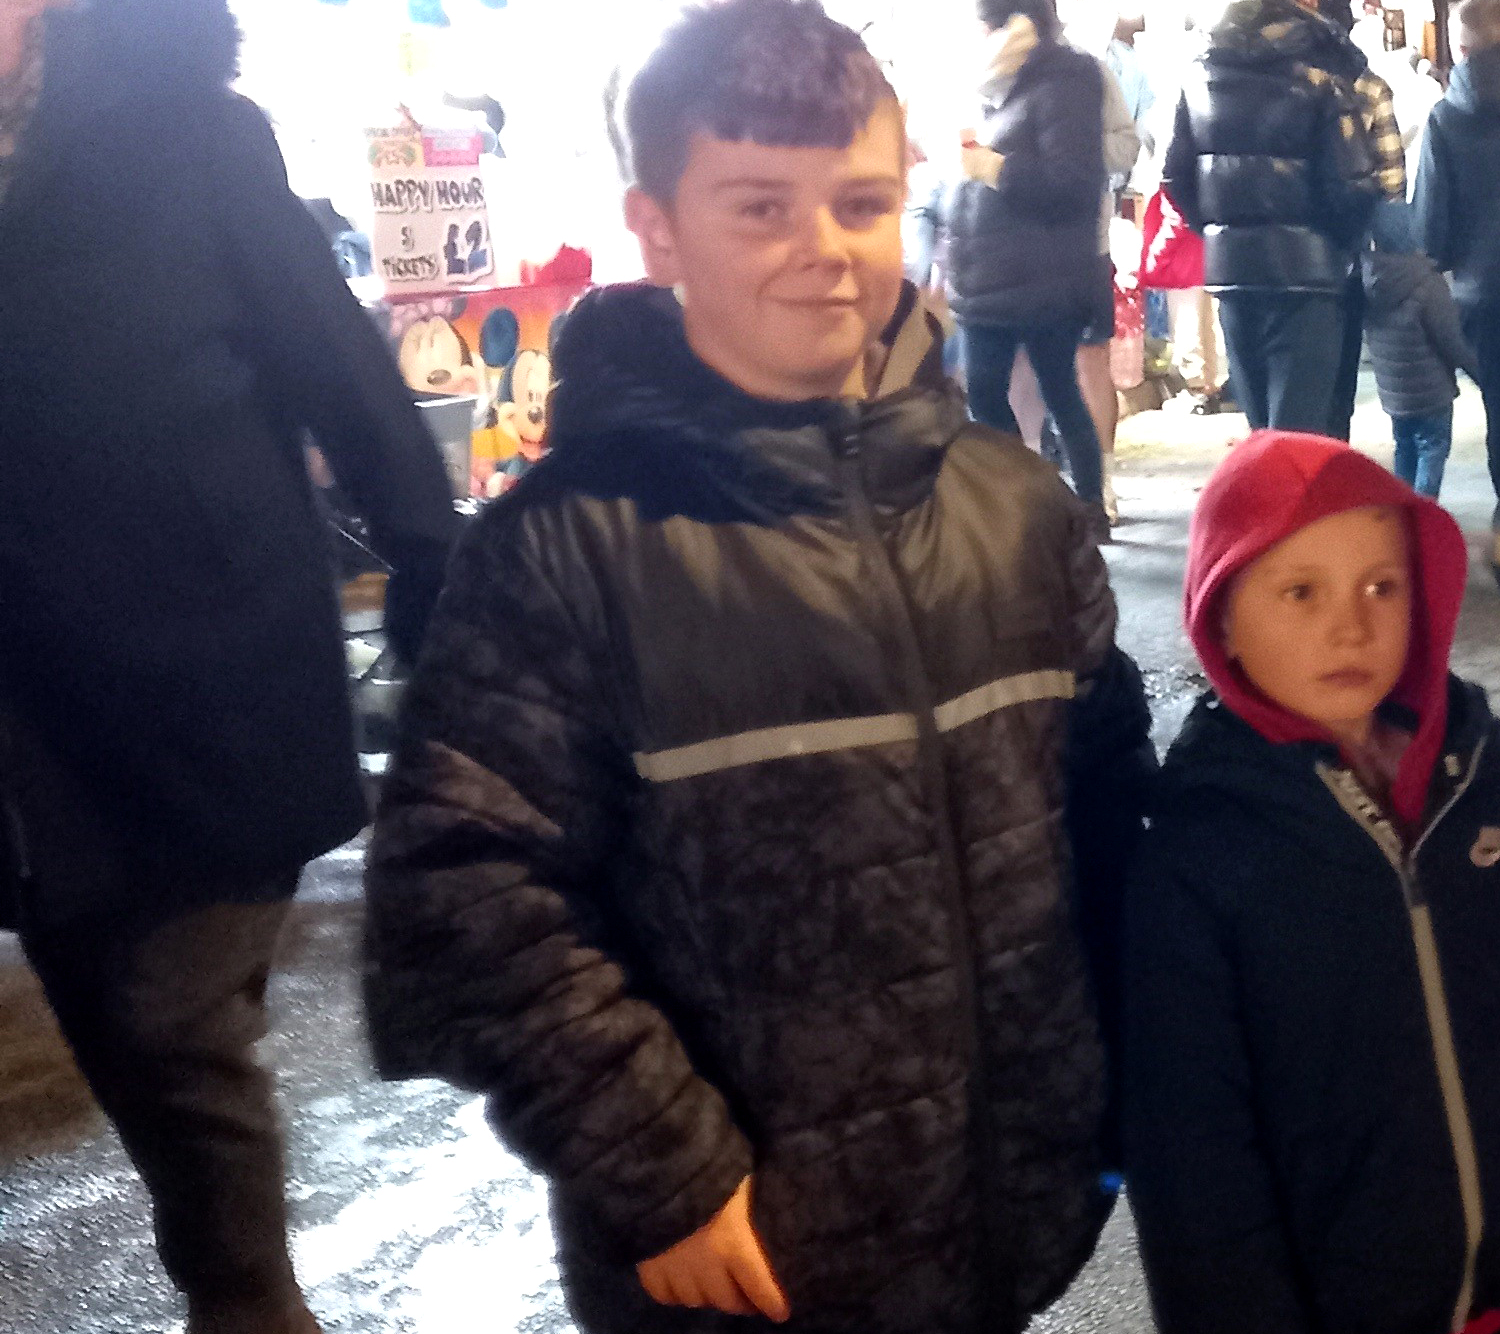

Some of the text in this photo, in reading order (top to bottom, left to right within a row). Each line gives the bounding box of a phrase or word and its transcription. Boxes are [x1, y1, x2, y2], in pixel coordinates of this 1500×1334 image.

[370, 176, 484, 208] HAPPY HOUR
[443, 220, 487, 275] £2
